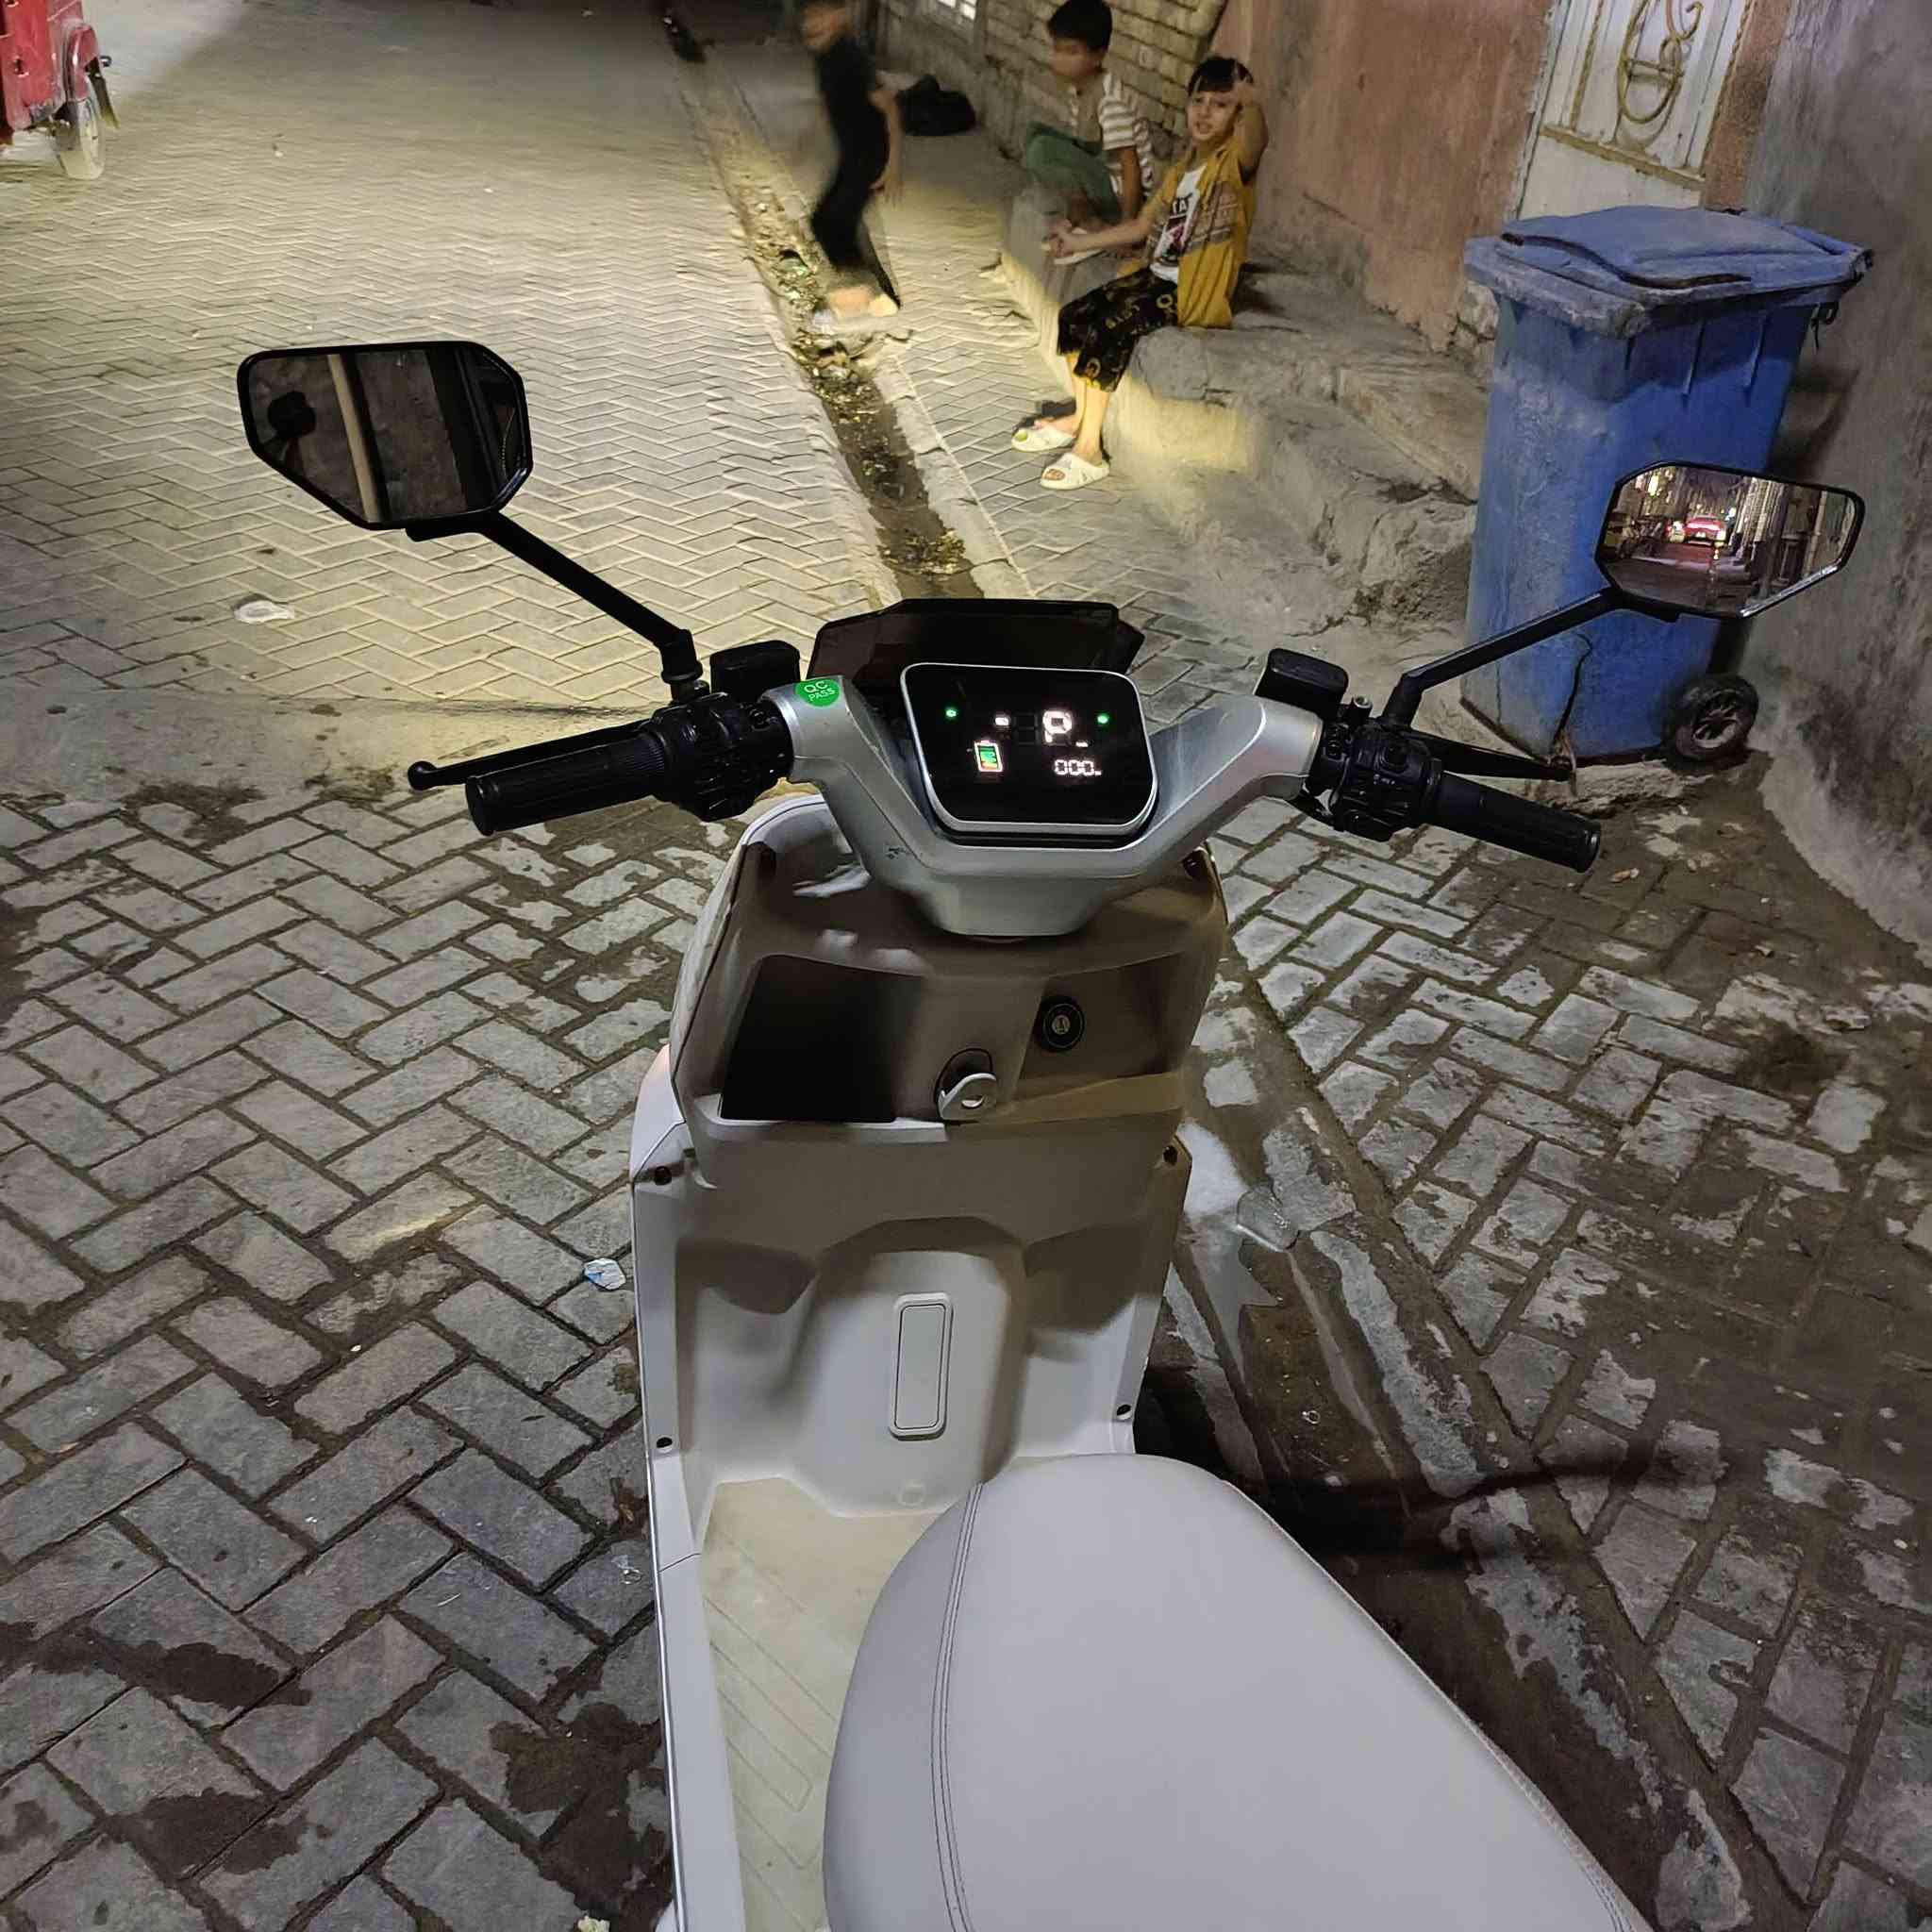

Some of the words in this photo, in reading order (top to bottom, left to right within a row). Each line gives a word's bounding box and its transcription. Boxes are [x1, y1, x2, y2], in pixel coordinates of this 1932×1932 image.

[804, 681, 828, 693] QC
[808, 688, 835, 701] PASS
[1042, 710, 1073, 743] P
